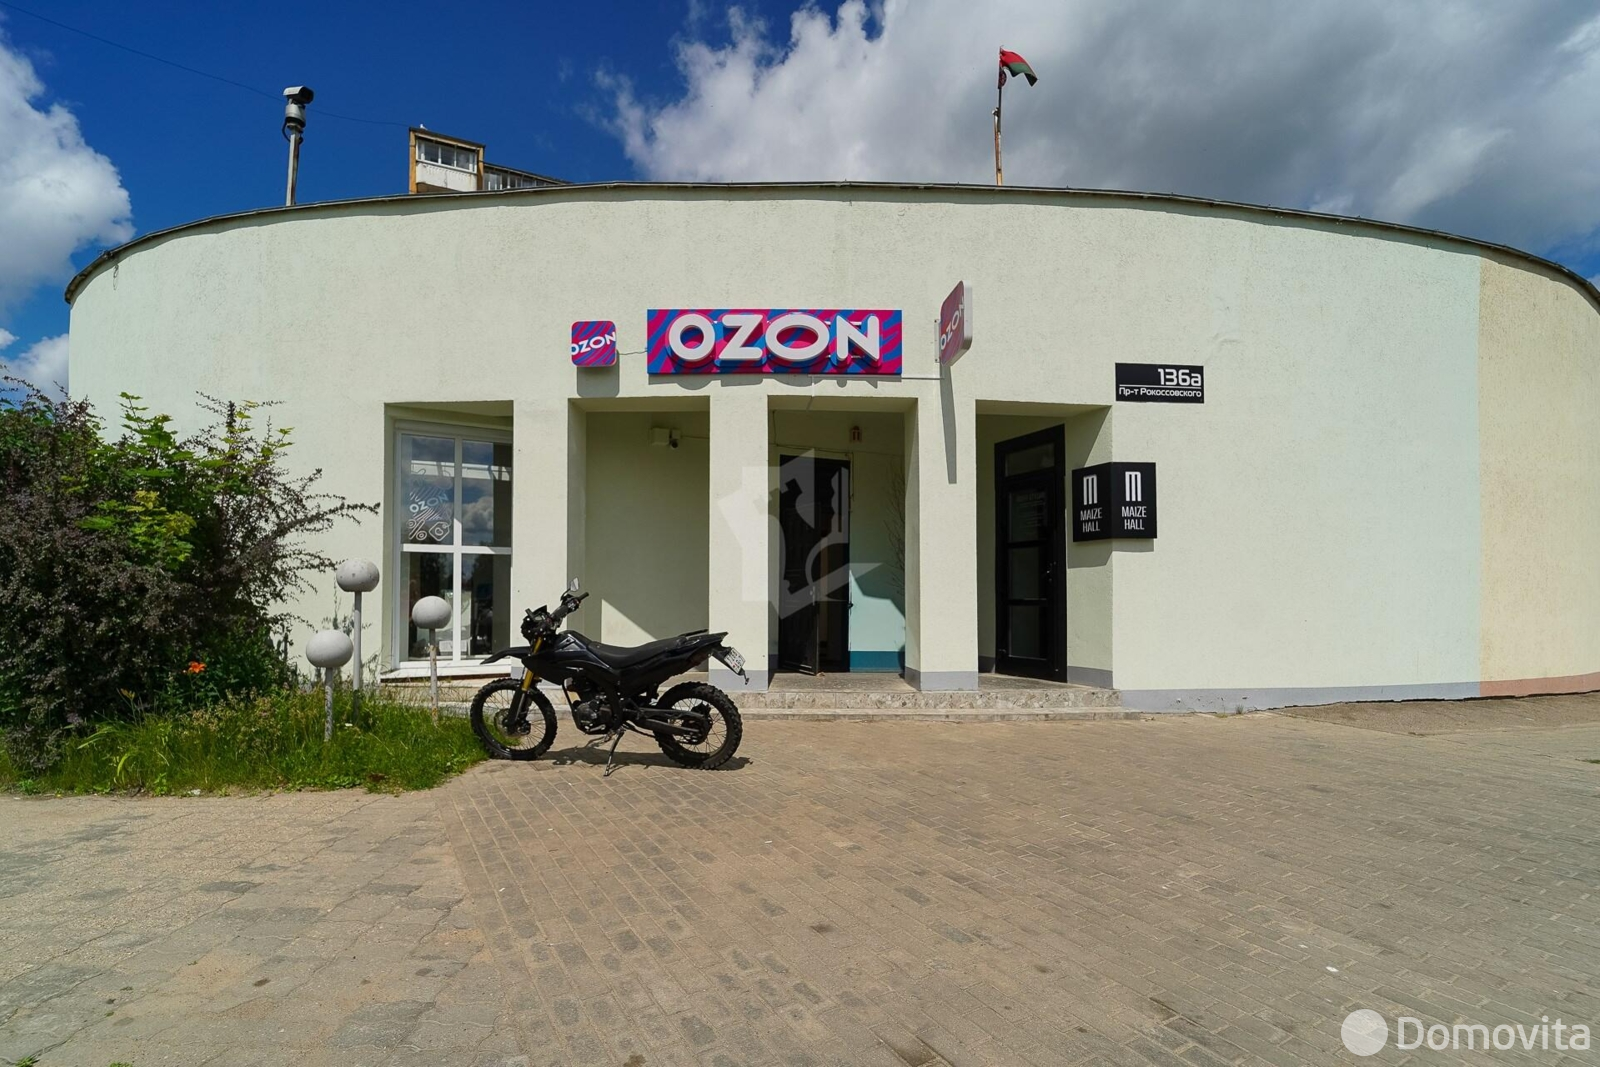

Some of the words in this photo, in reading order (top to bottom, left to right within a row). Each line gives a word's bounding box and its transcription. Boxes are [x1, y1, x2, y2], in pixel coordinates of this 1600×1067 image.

[941, 296, 964, 350] OZON
[571, 331, 616, 356] OZON
[668, 313, 880, 362] OZON
[1157, 368, 1202, 387] 136а
[1119, 387, 1139, 397] Пр-т
[1140, 387, 1202, 398] Рокоссовского
[409, 493, 449, 513] OZON
[1080, 507, 1103, 521] MAIZE
[1121, 506, 1147, 518] MAIZE
[1082, 520, 1101, 533] HALL
[1124, 518, 1145, 530] HALL
